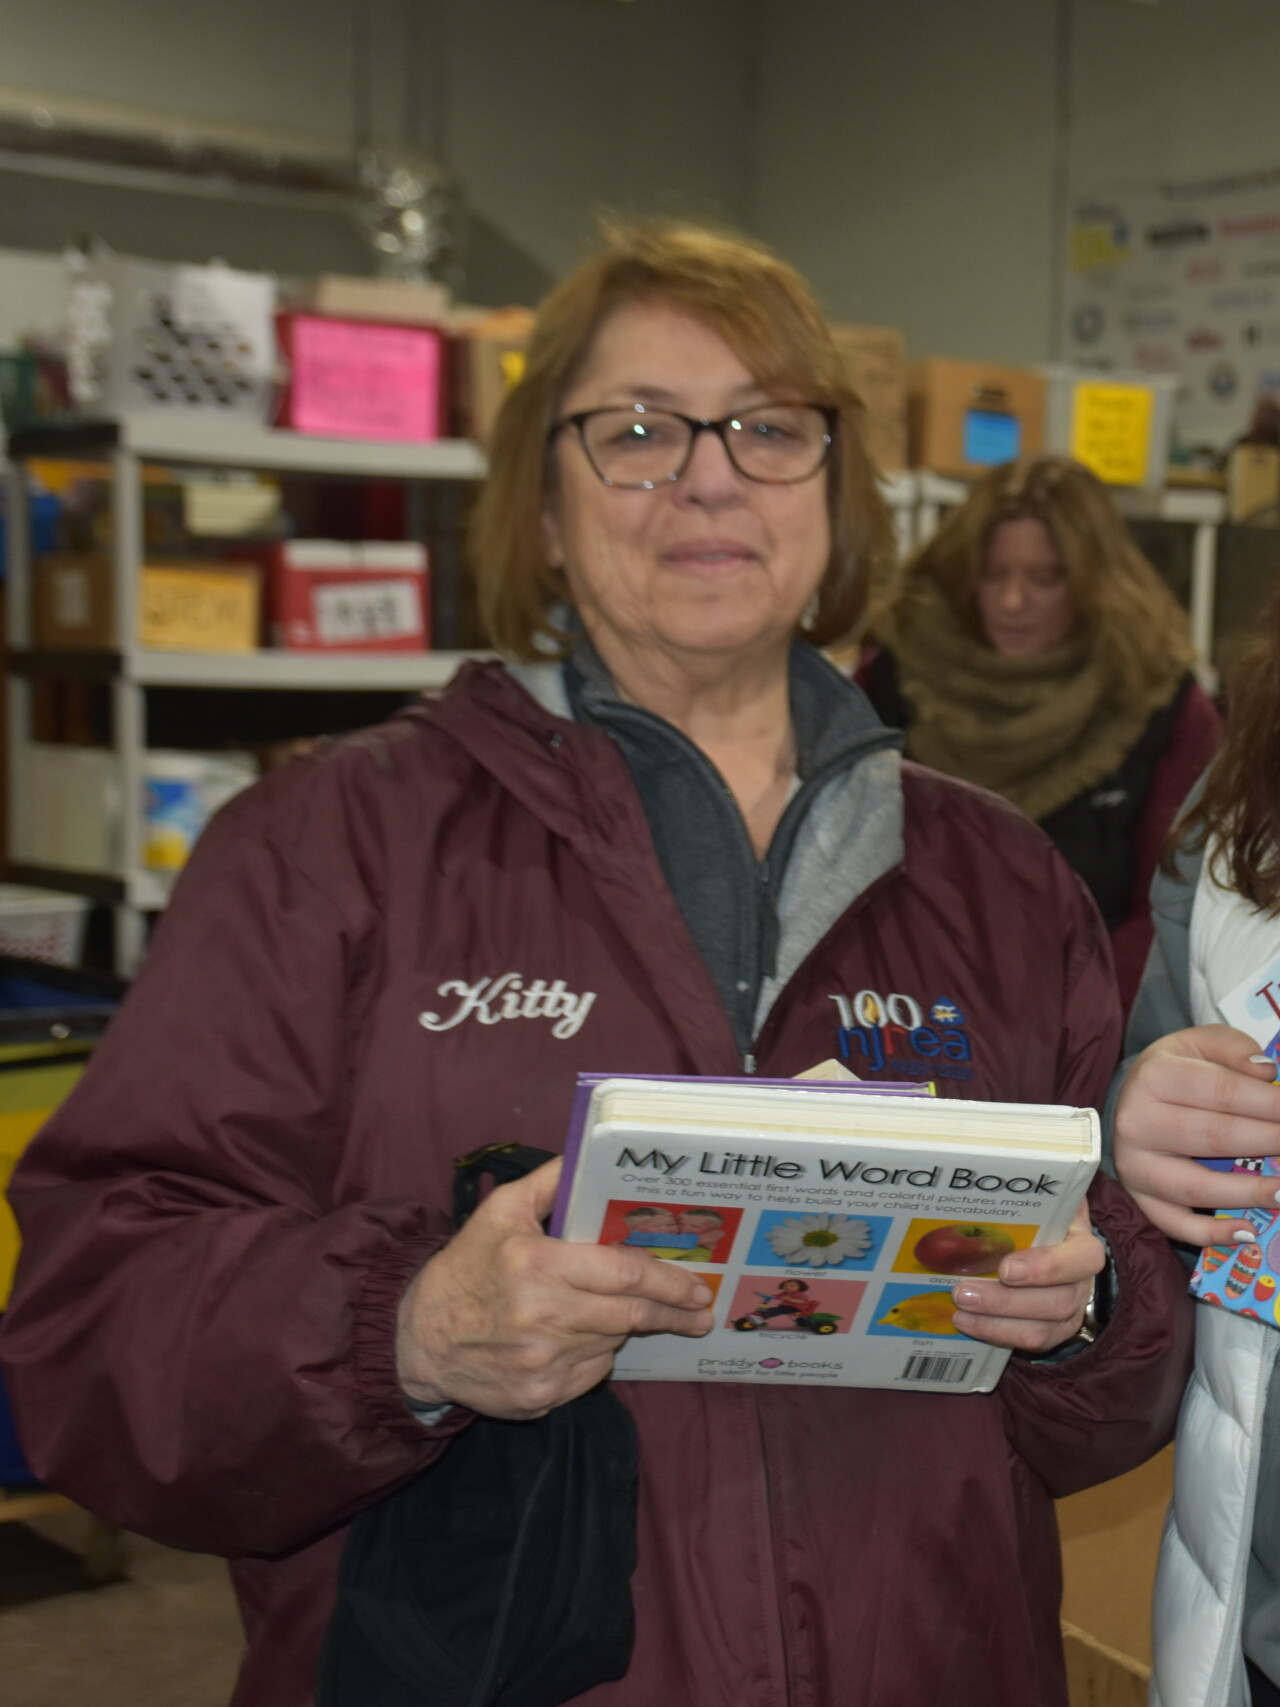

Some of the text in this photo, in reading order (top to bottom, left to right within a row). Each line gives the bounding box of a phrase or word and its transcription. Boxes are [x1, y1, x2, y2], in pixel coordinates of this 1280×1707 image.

[418, 971, 598, 1040] Kitty
[827, 989, 923, 1031] 100
[616, 1147, 1060, 1195] My Little Word Book
[621, 1174, 1042, 1208] Over 300 essential first words and colorful pictures make
[636, 1186, 1022, 1217] this a fun way to help build your child's vocabulary.
[787, 1359, 844, 1369] books
